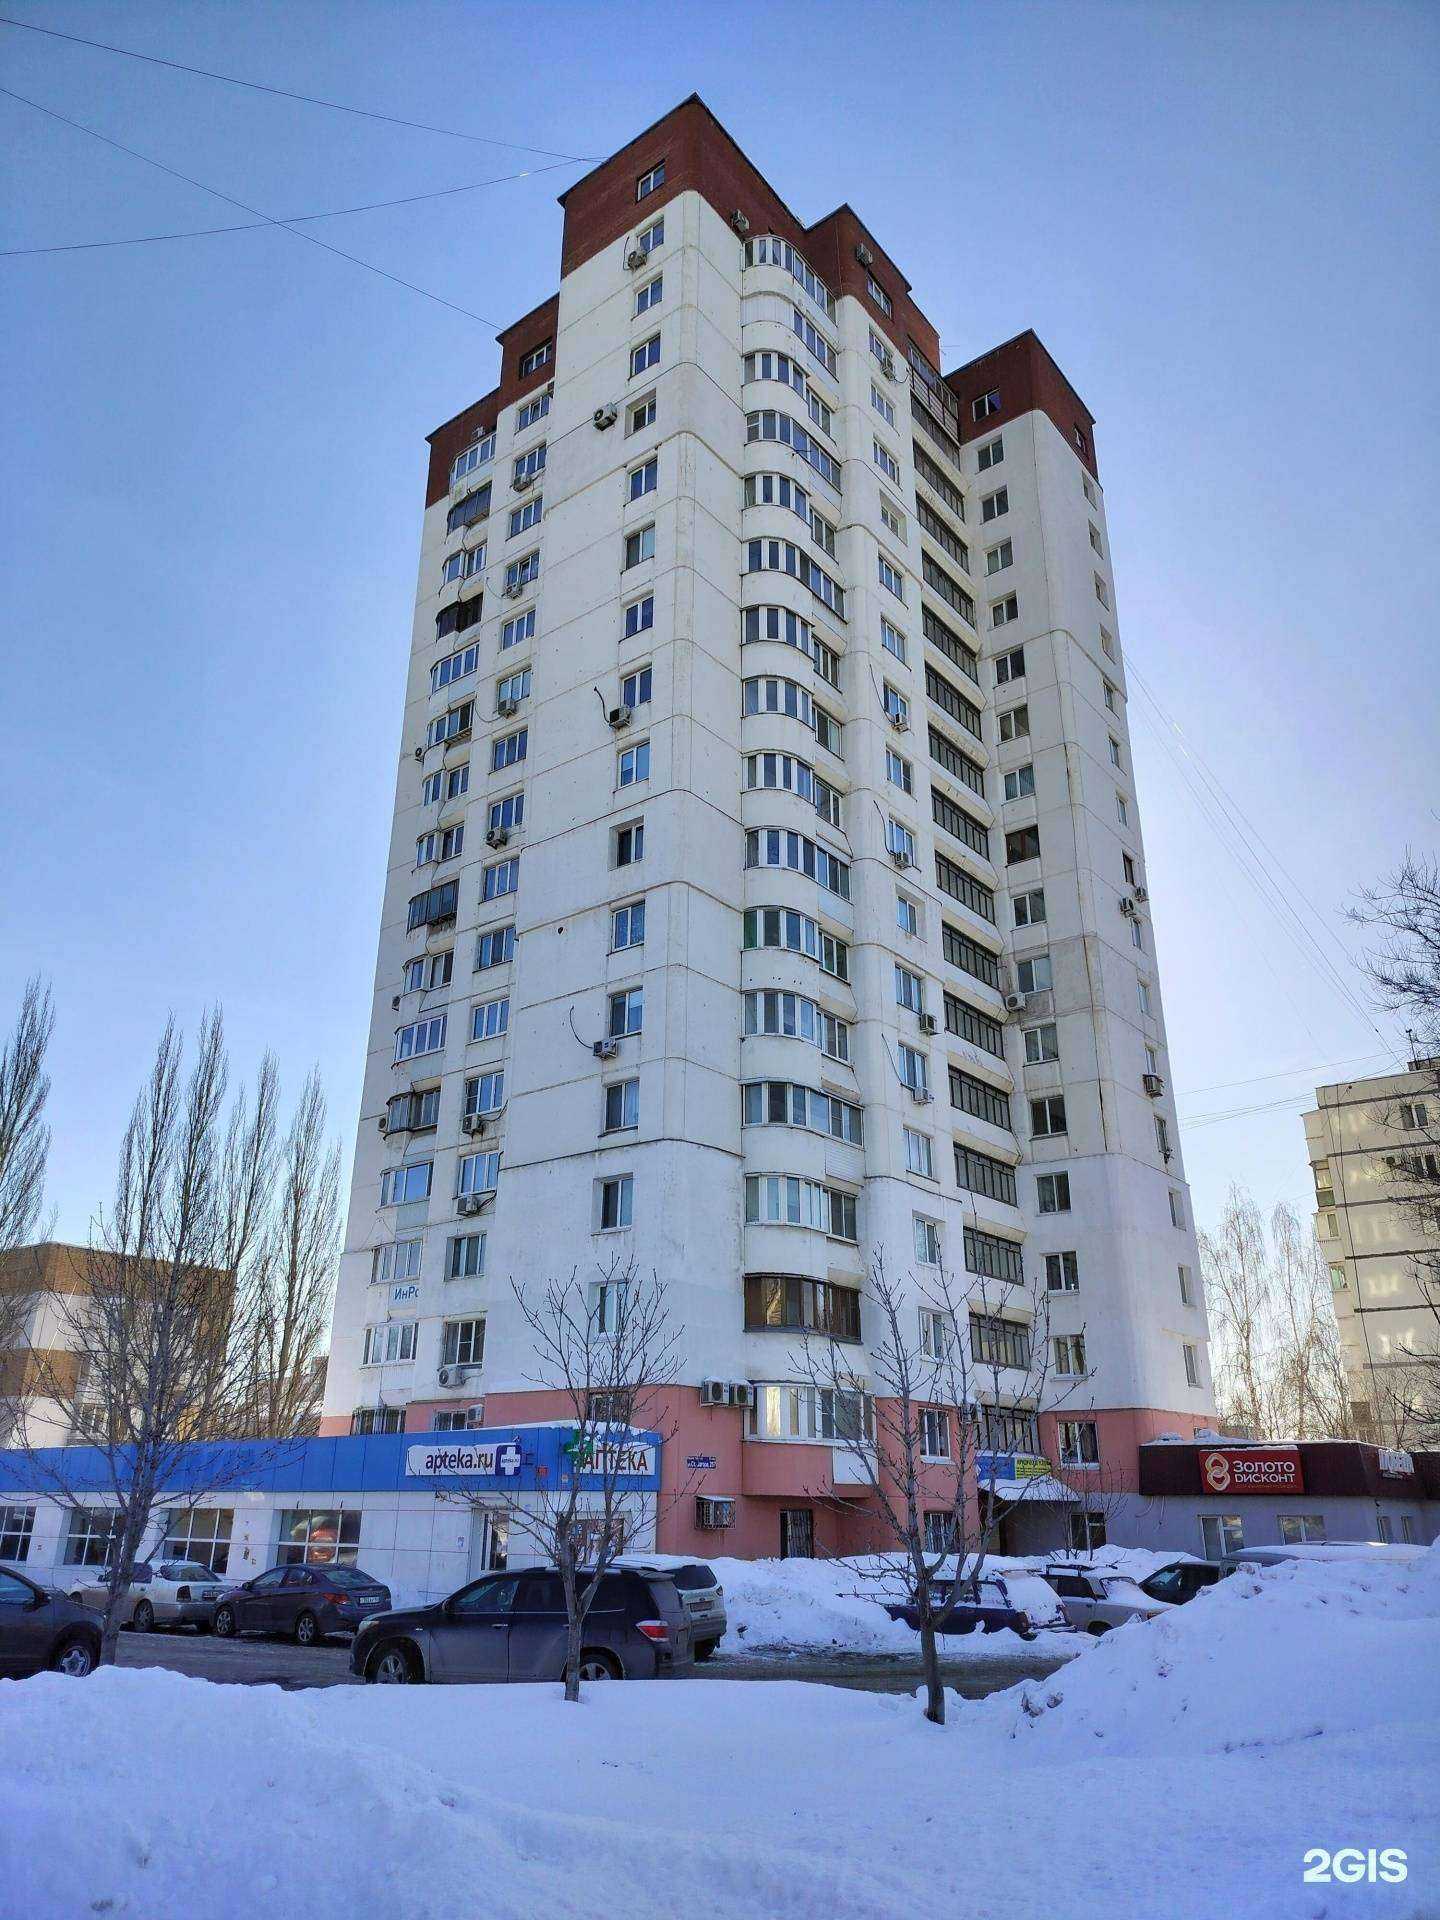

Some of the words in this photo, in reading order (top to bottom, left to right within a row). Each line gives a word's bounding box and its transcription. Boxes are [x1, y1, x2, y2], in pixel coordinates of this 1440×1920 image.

[425, 1448, 494, 1474] apteka.ru
[582, 1449, 648, 1471] АПТЕКА
[1232, 1461, 1296, 1473] ЗОЛОТО
